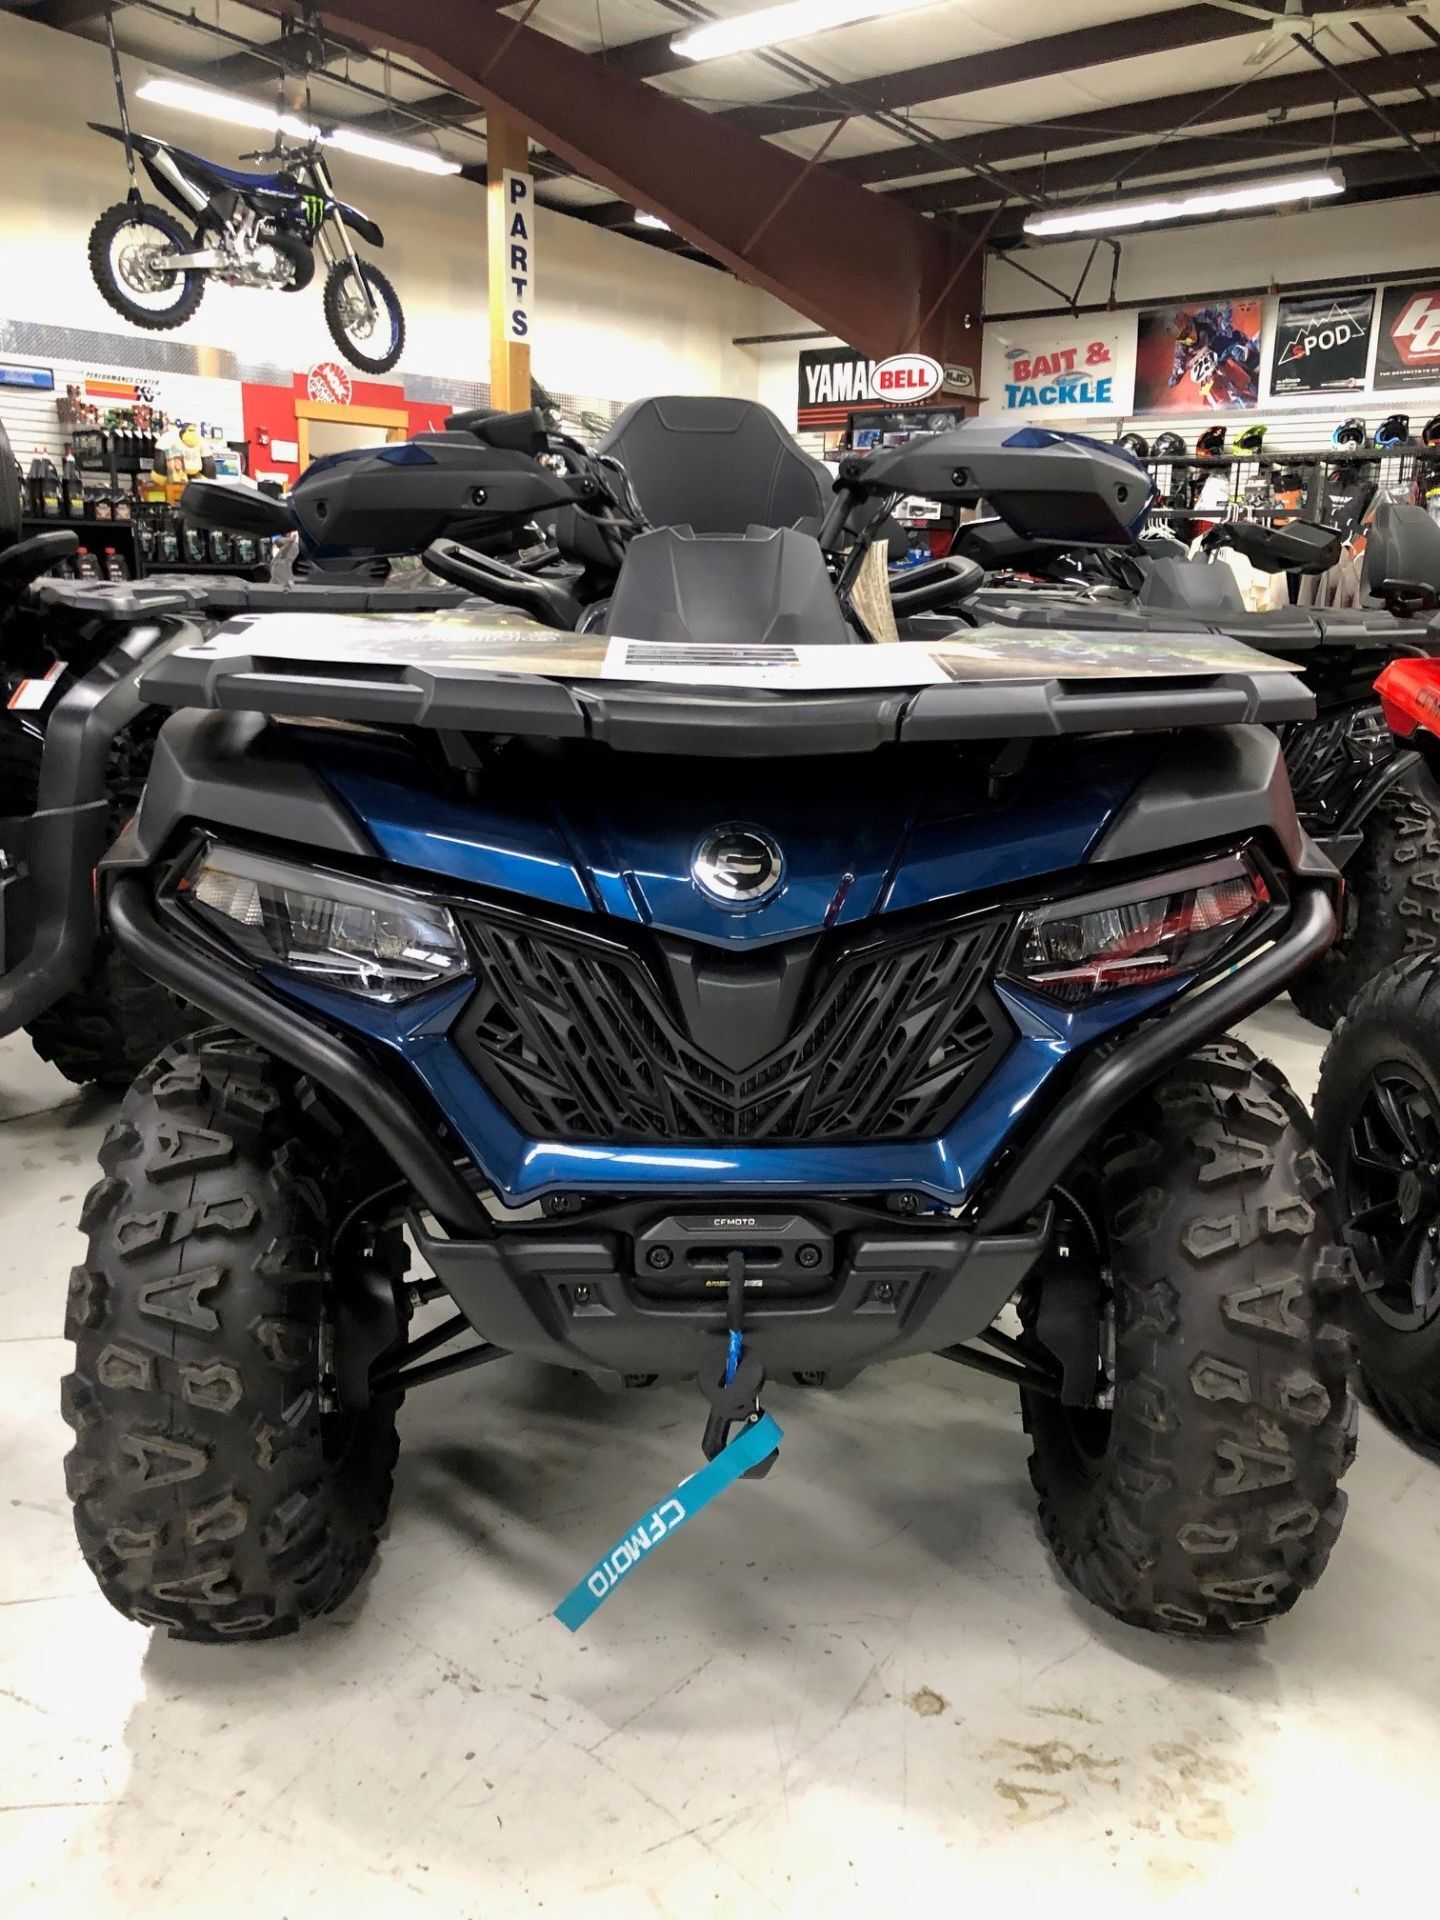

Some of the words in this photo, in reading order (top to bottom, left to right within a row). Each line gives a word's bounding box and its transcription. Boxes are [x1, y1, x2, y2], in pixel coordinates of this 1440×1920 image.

[510, 177, 528, 336] PARTS
[86, 371, 134, 383] PERFORMANCE
[1013, 347, 1078, 383] BAIT
[1085, 341, 1112, 367] &
[880, 368, 929, 390] BELL
[1004, 377, 1113, 409] TACKLE
[713, 1218, 755, 1226] CFMOTO
[587, 1498, 686, 1598] CFMOTO
